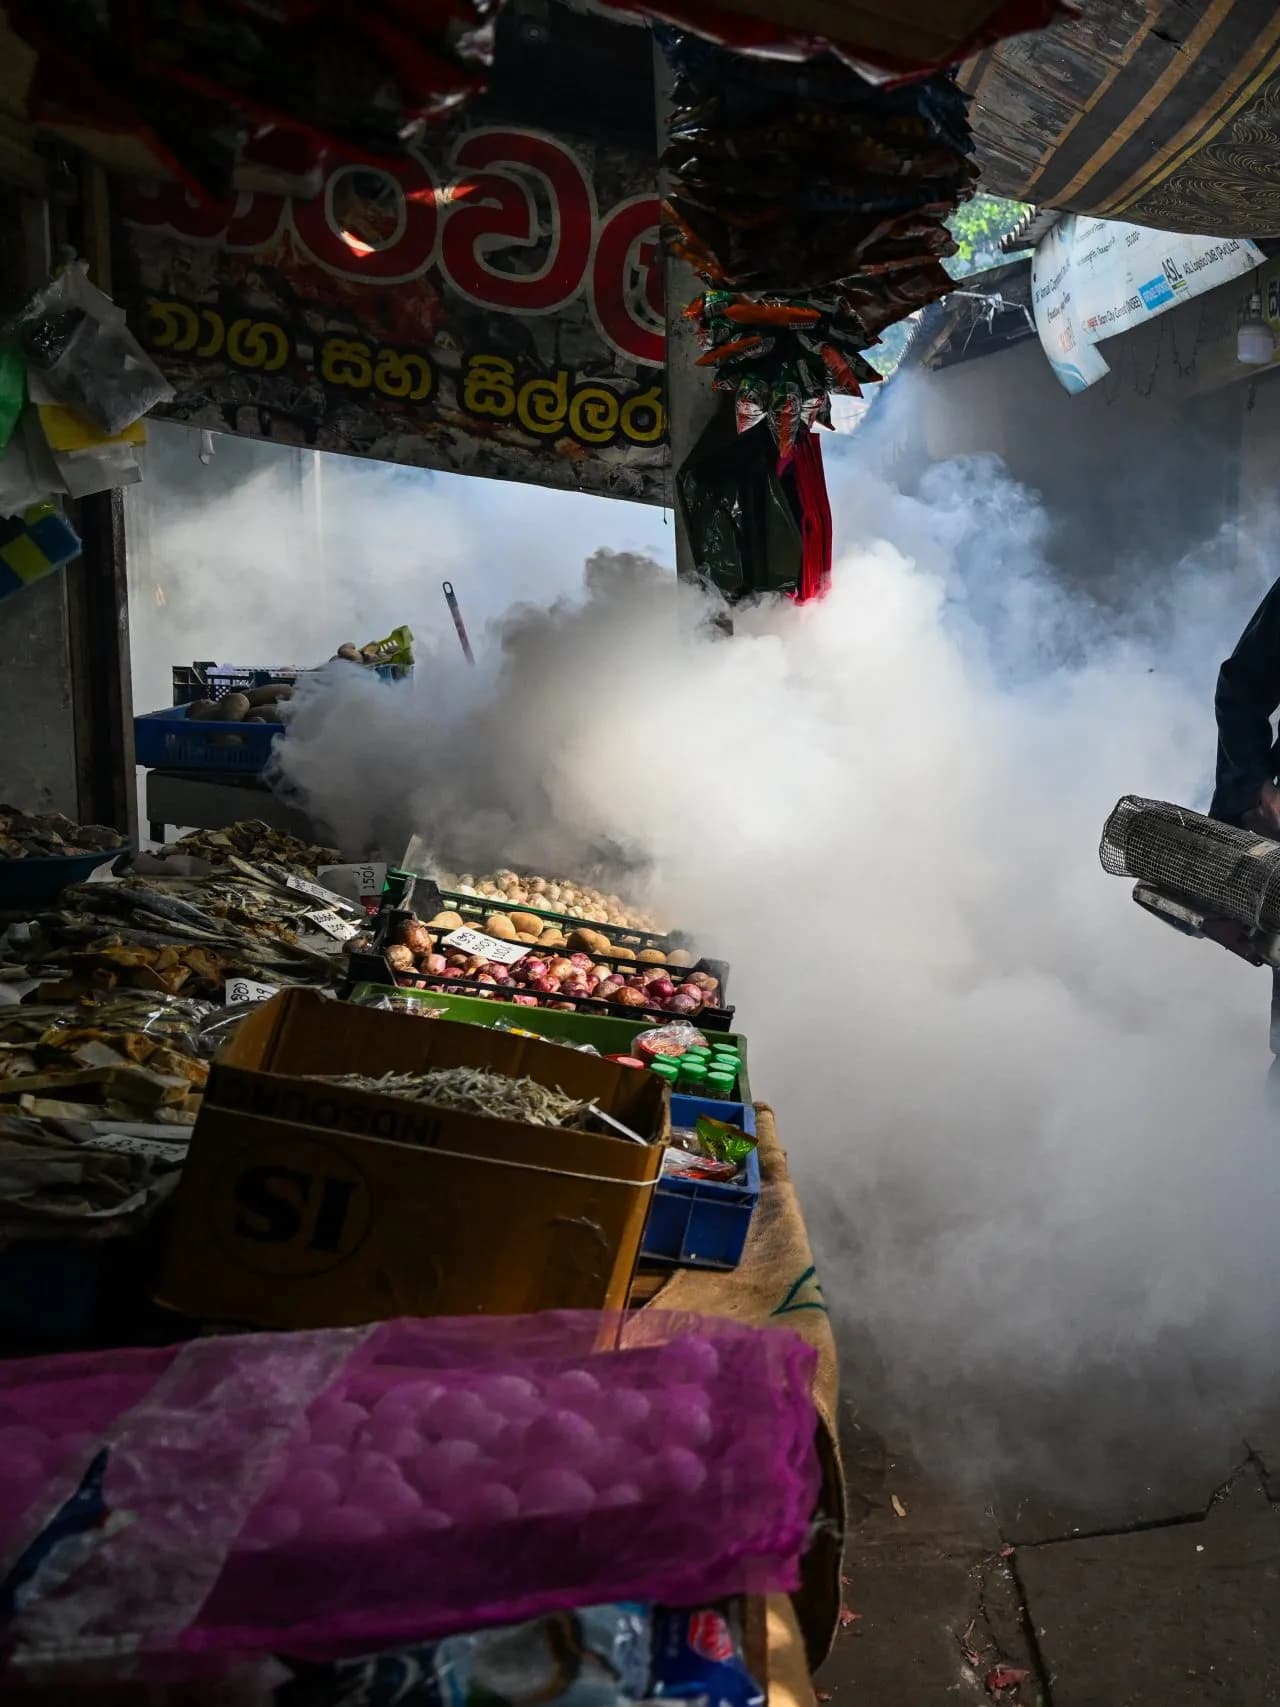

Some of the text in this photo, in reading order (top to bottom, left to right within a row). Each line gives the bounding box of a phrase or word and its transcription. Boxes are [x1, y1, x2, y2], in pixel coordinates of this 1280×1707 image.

[1161, 257, 1184, 284] ASL
[322, 335, 433, 401] සහ
[462, 354, 667, 443] සිල්ලර
